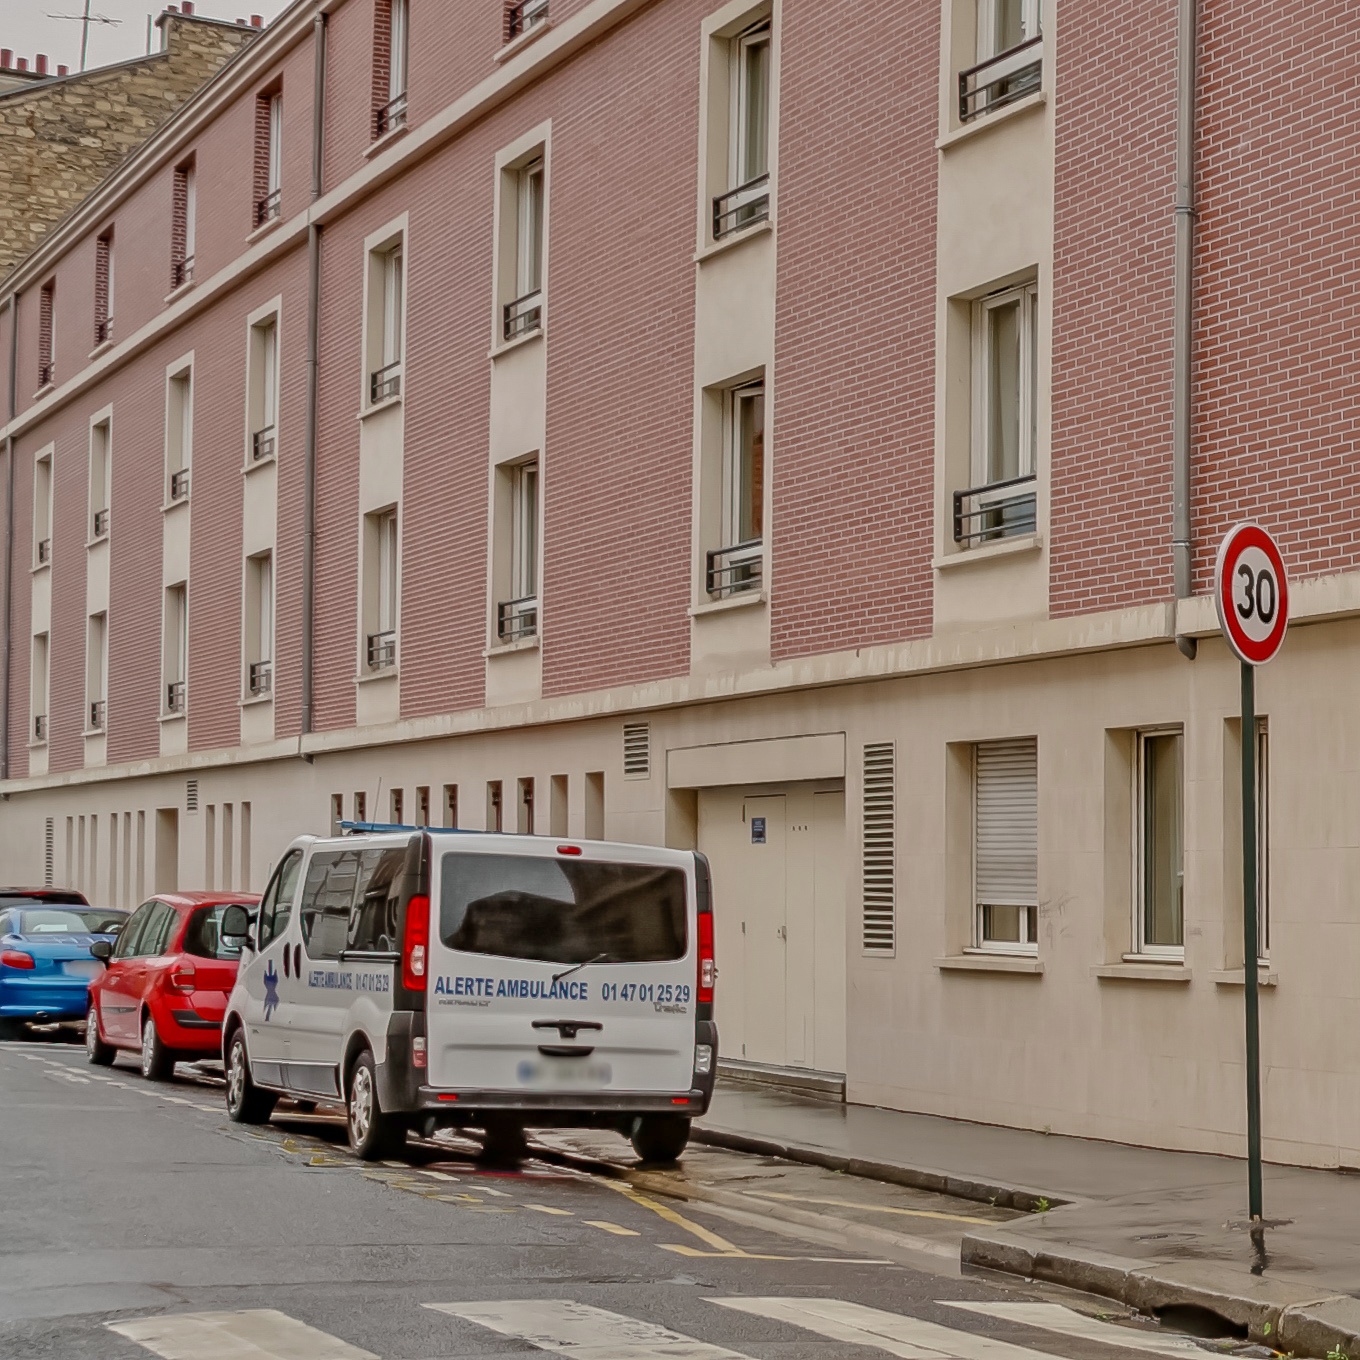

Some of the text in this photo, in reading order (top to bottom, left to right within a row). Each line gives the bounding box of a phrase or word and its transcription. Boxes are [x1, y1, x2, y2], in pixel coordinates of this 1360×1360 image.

[1237, 564, 1275, 624] 30
[434, 976, 588, 1000] ALERTE AMBULANCE
[602, 983, 690, 1003] 01 47 01 25 29
